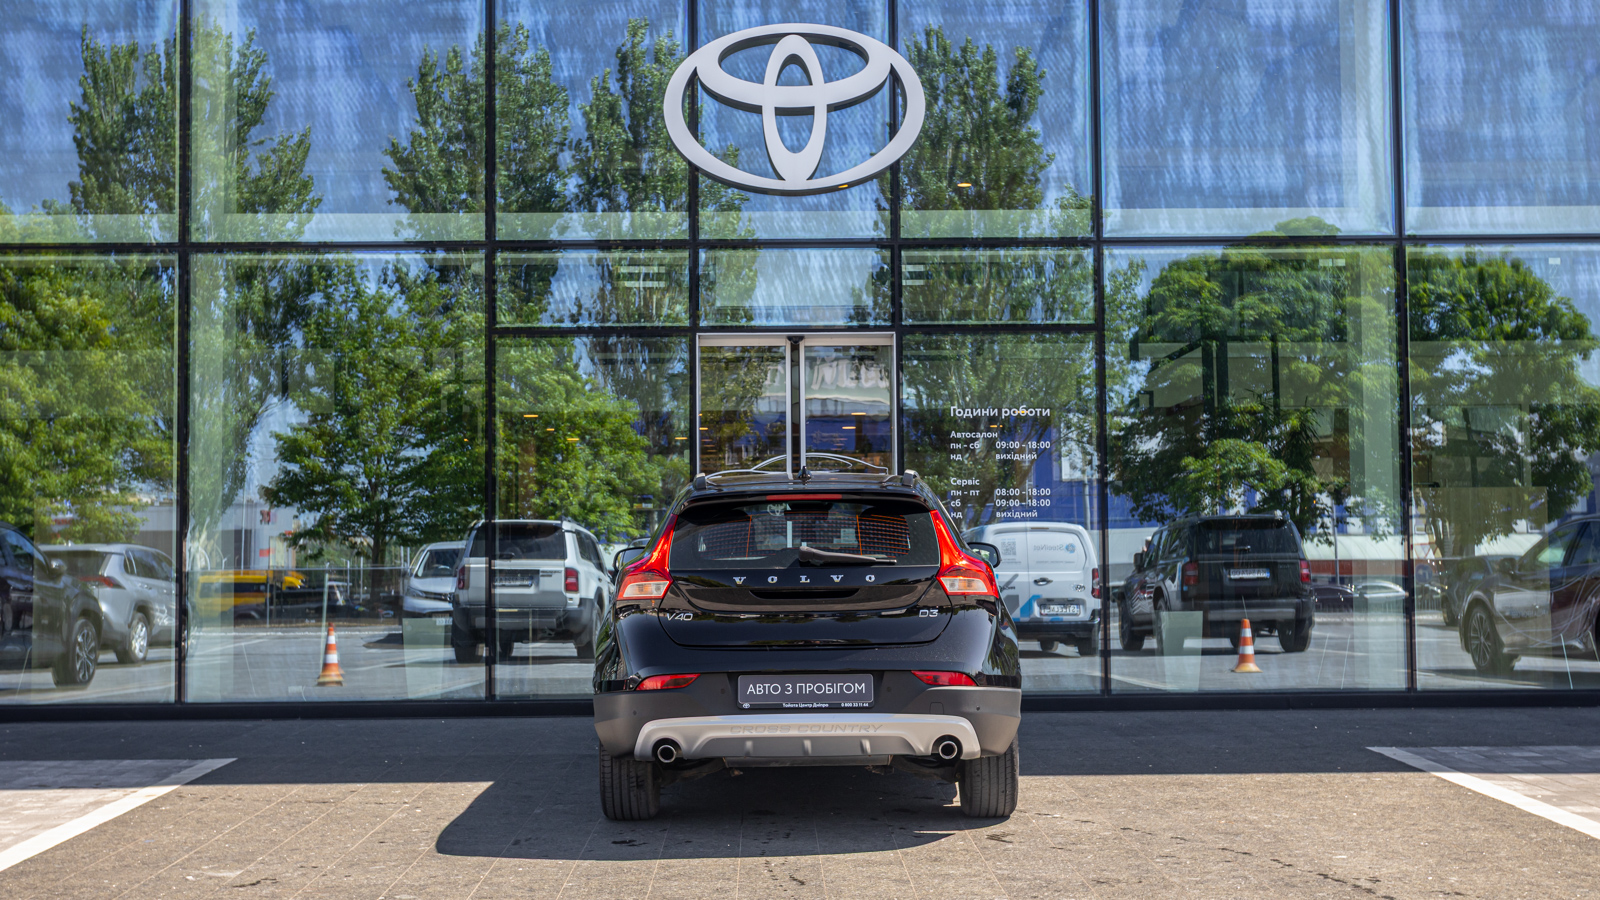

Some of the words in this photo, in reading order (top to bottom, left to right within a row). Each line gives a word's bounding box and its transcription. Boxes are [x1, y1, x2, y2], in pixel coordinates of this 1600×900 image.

[950, 406, 998, 418] Години
[1002, 405, 1051, 419] роботи
[969, 441, 980, 449] сб
[995, 441, 1020, 449] 09:00
[1027, 441, 1051, 449] 18:00
[950, 453, 962, 461] нд
[995, 452, 1037, 461] вихідний
[950, 477, 980, 487] Сервіс
[995, 488, 1020, 496] 08:00
[1027, 488, 1051, 496] 18:00
[950, 499, 961, 507] сб
[995, 499, 1020, 507] 09:00
[1027, 499, 1051, 507] 18:00
[996, 510, 1038, 519] вихідний
[733, 574, 876, 585] VOLVO
[666, 612, 694, 621] V40
[918, 609, 939, 618] D3
[746, 683, 781, 695] АВТО
[784, 683, 793, 694] З
[796, 682, 866, 694] ПРОБІГОМ
[730, 725, 791, 734] CROSS
[797, 724, 883, 734] COUNTRY
